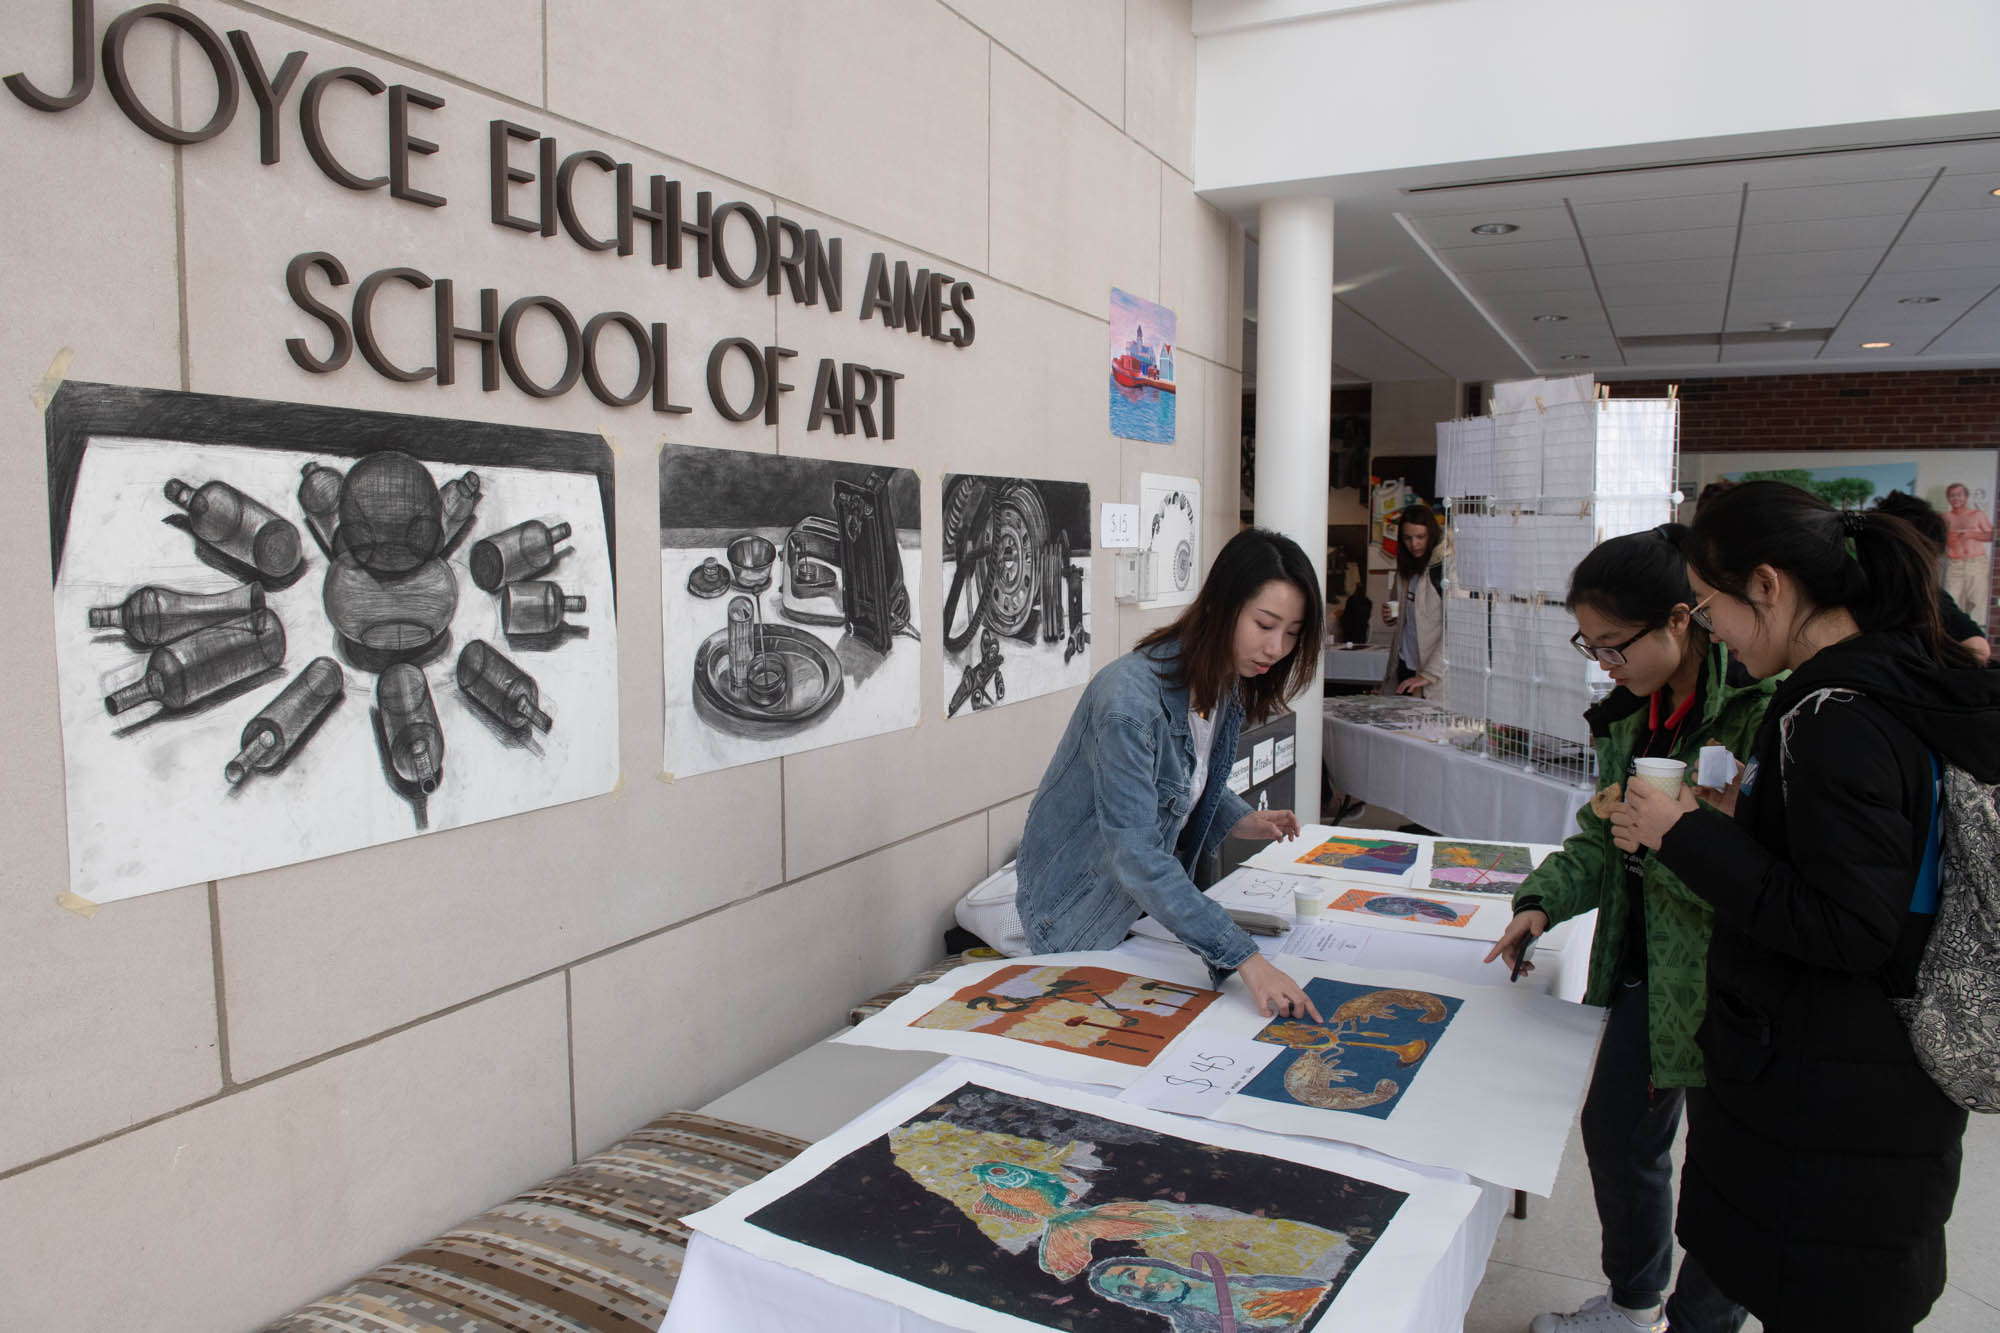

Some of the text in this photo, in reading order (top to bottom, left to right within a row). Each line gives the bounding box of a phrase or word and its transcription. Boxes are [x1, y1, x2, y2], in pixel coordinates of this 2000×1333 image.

[2, 0, 975, 347] JOYCE EICHHORN AMES
[286, 251, 904, 440] SCHOOL OF ART
[1162, 1052, 1235, 1094] $45
